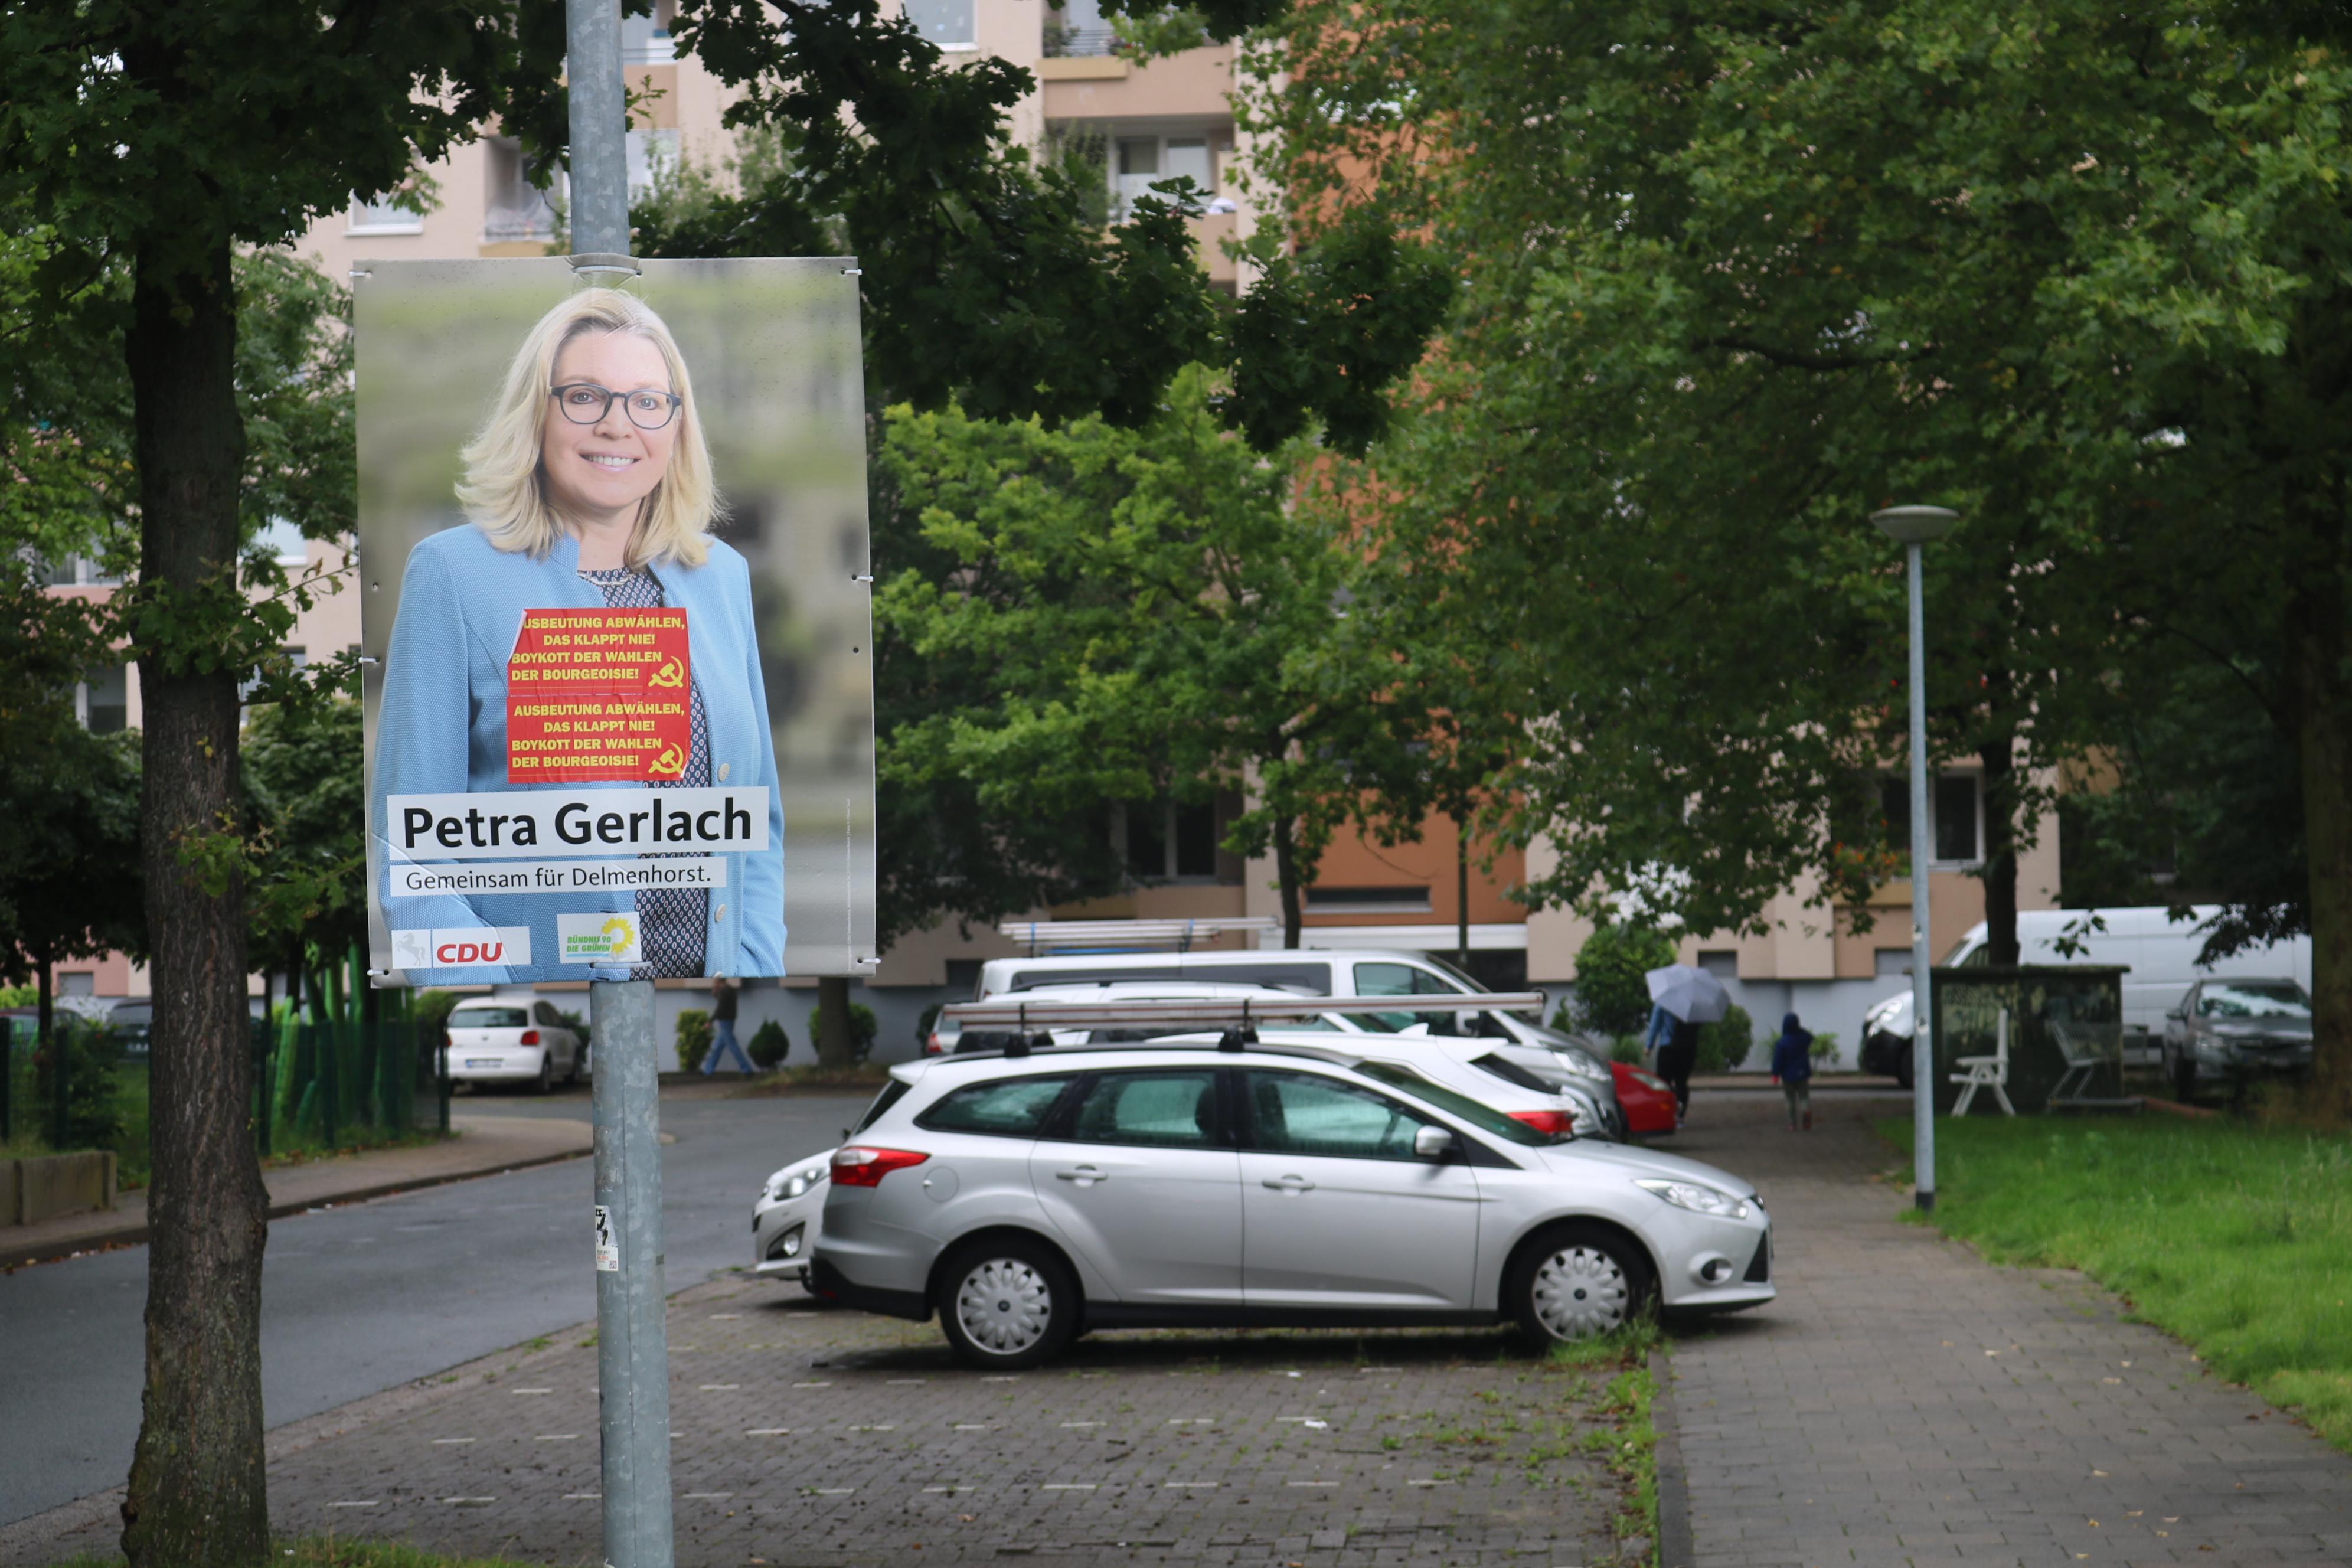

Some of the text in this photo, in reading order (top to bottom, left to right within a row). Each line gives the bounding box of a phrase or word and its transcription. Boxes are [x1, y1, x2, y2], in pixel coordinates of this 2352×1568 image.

[524, 615, 685, 629] USBEUTUNG ABWÄHLEN,
[544, 634, 655, 645] DAS KLAPPT NIE!
[512, 652, 661, 664] BOYKOTT DER WAHLEN
[512, 668, 639, 680] DER BOURGEOISIE!
[514, 701, 684, 716] AUSBEUTUNG ABWÄHLEN,
[544, 720, 655, 732] DAS KLAPPT NIE!
[512, 738, 661, 750] BOYKOTT DER WAHLEN
[512, 755, 638, 767] DER BOURGEOISIE!
[404, 798, 750, 848] Petra Gerlach
[407, 865, 710, 889] Gemeinsam für Delmenhorst.
[438, 943, 501, 963] CDU
[582, 943, 610, 952] GRÜNEN
